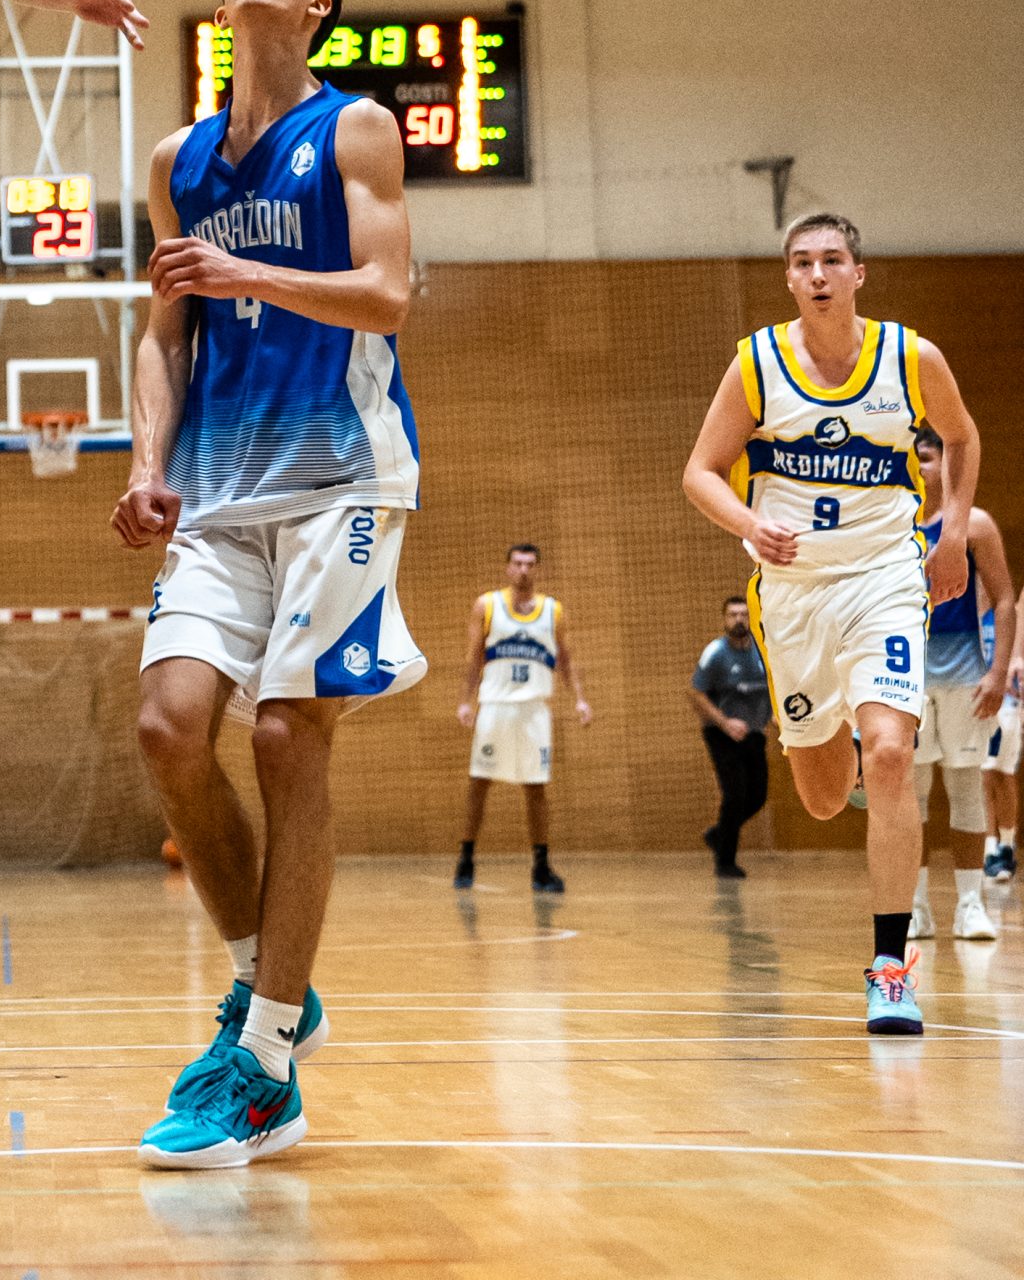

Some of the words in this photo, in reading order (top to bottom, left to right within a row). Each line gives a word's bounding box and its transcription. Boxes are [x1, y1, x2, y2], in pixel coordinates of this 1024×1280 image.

[406, 104, 454, 146] 50
[813, 496, 841, 531] 9
[885, 635, 911, 674] 9
